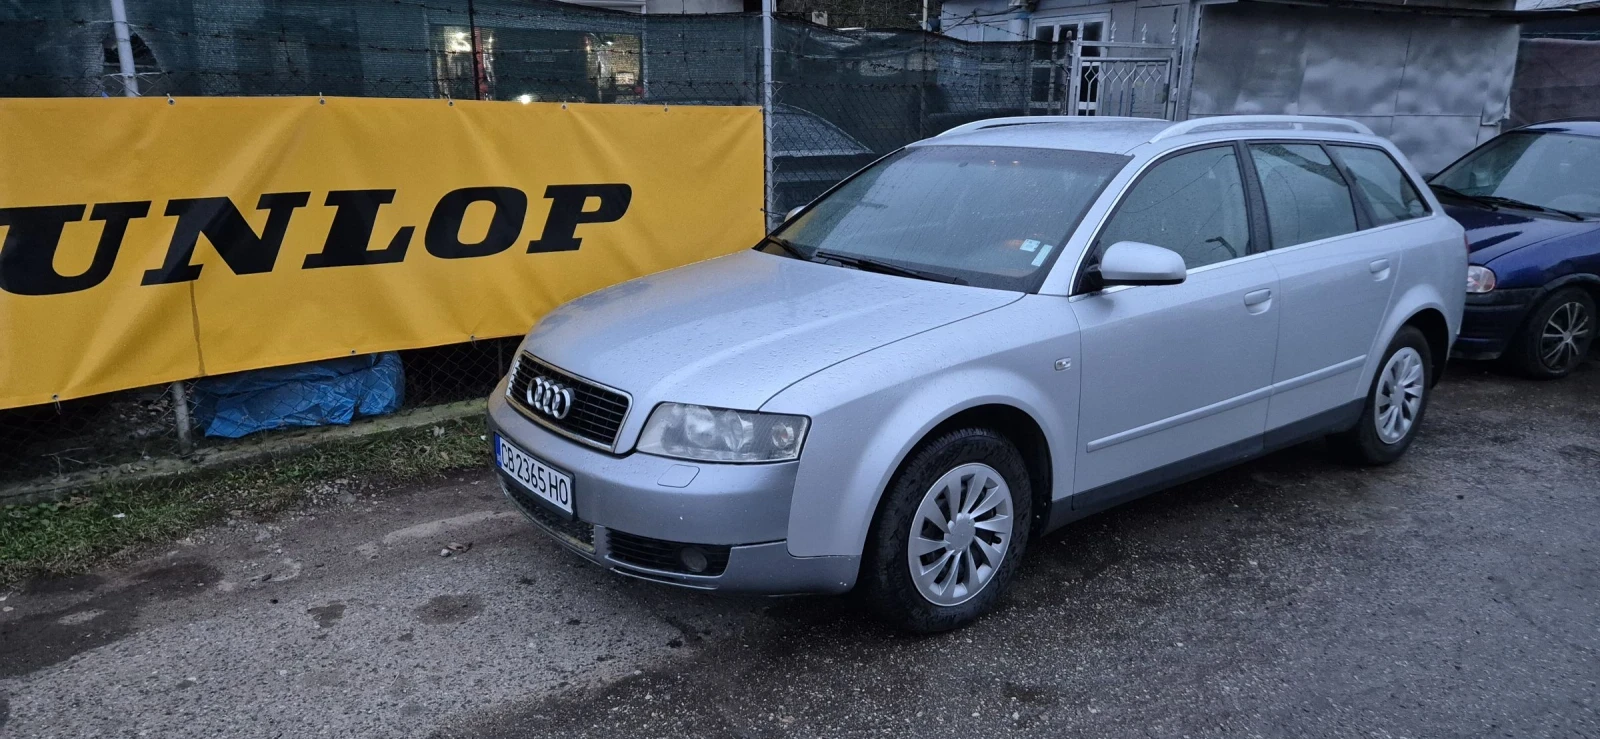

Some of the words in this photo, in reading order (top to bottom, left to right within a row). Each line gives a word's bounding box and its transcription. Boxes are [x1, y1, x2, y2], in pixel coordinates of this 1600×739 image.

[0, 183, 632, 295] UNLOP
[502, 443, 515, 473] CB
[516, 453, 546, 493] 2365
[549, 471, 568, 505] HO
